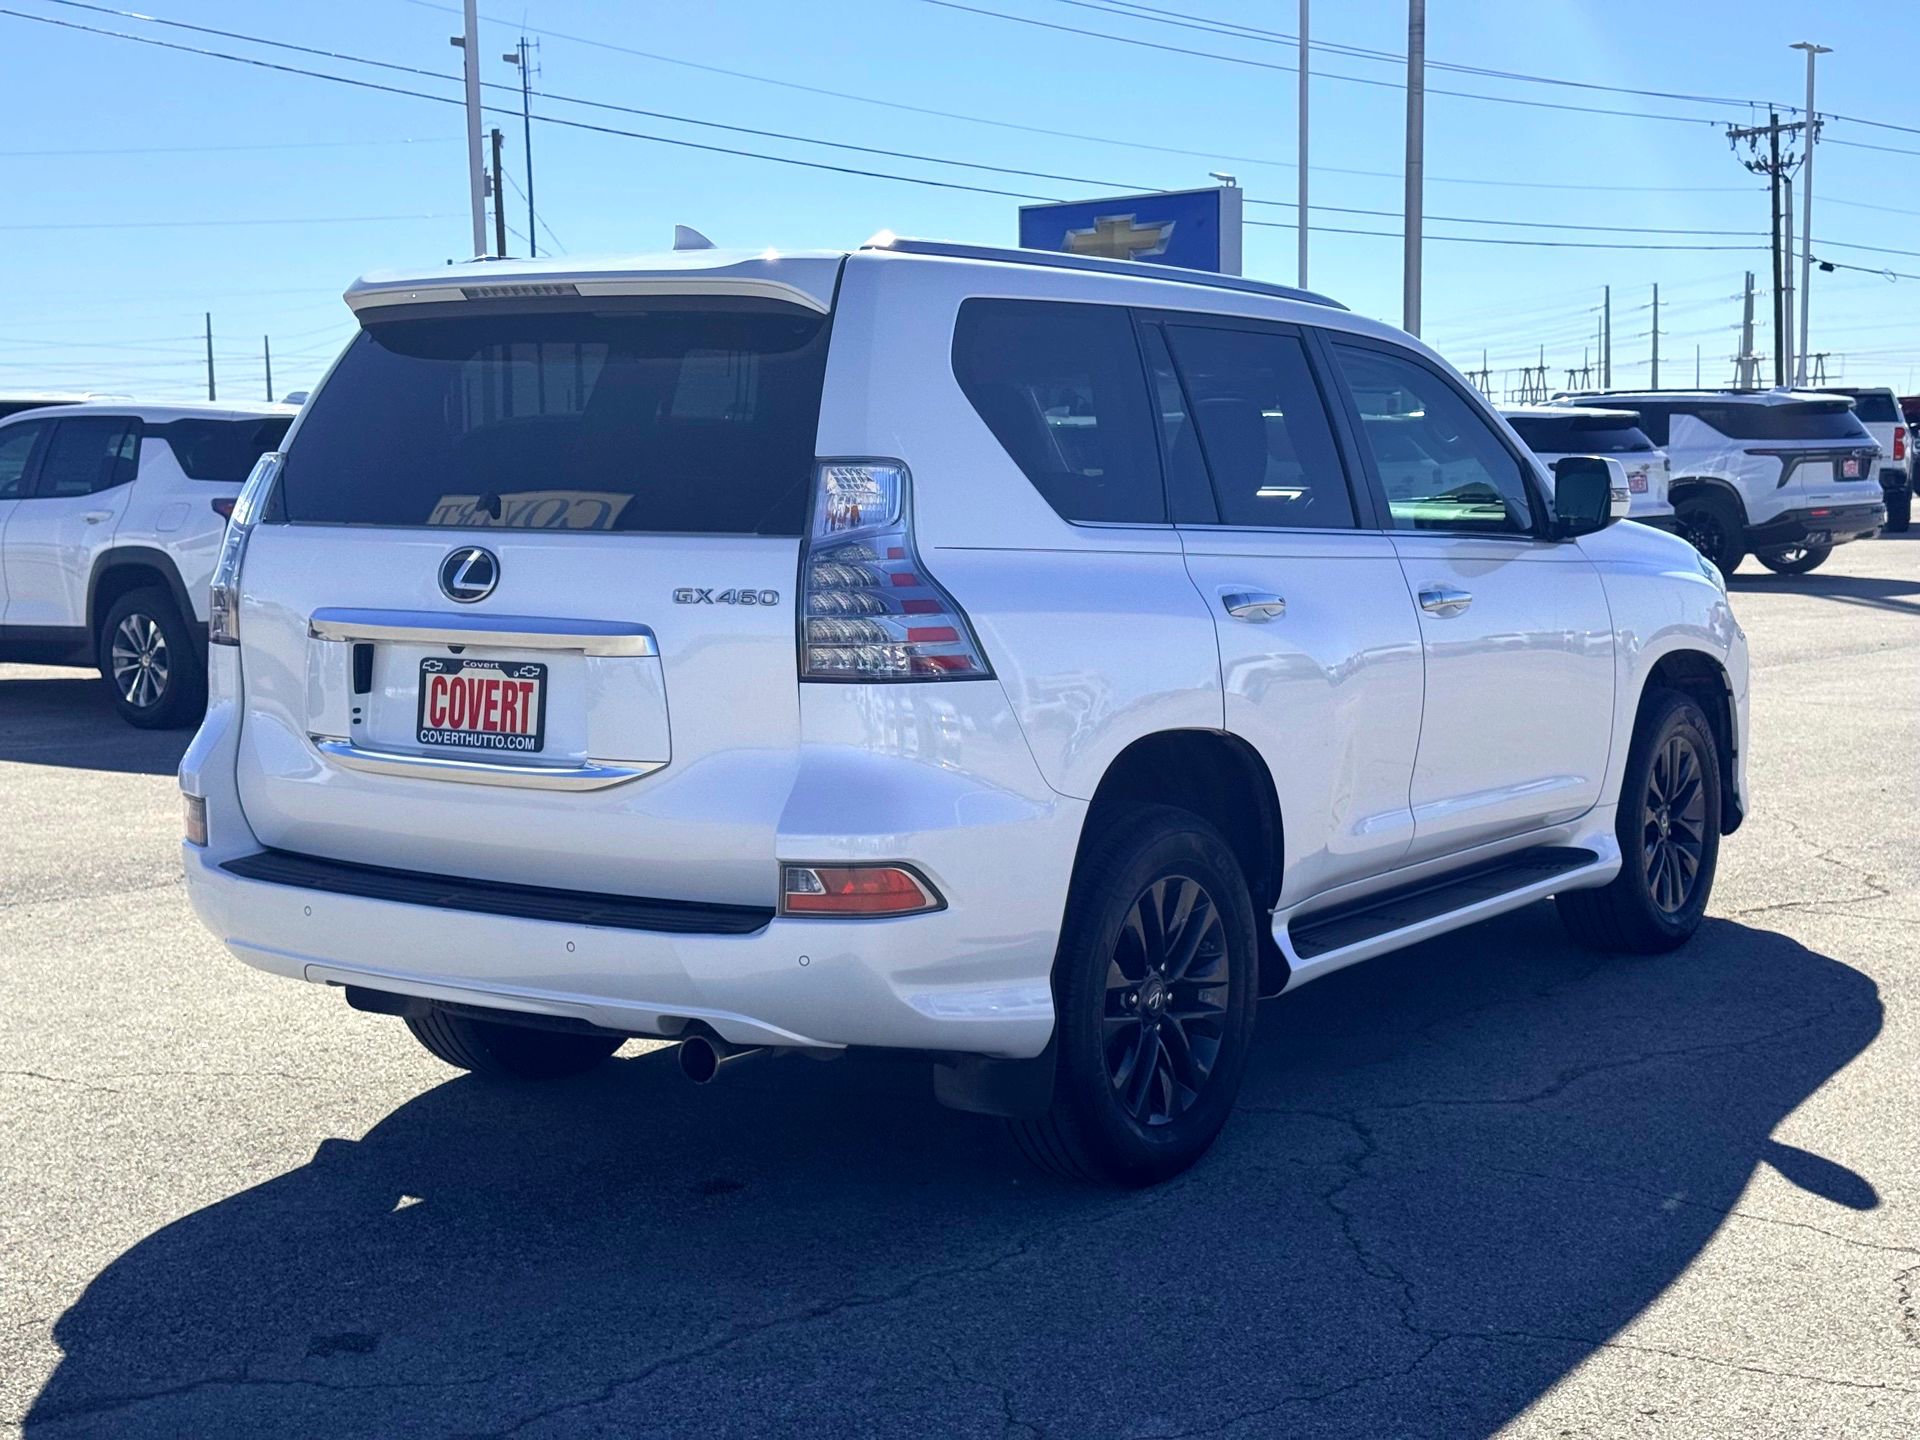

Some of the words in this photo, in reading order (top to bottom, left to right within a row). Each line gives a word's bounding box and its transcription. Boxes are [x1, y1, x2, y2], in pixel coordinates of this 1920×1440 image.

[462, 660, 500, 669] Covert
[429, 675, 534, 735] COVERT
[420, 729, 536, 751] COVERTHUTTO.COM
